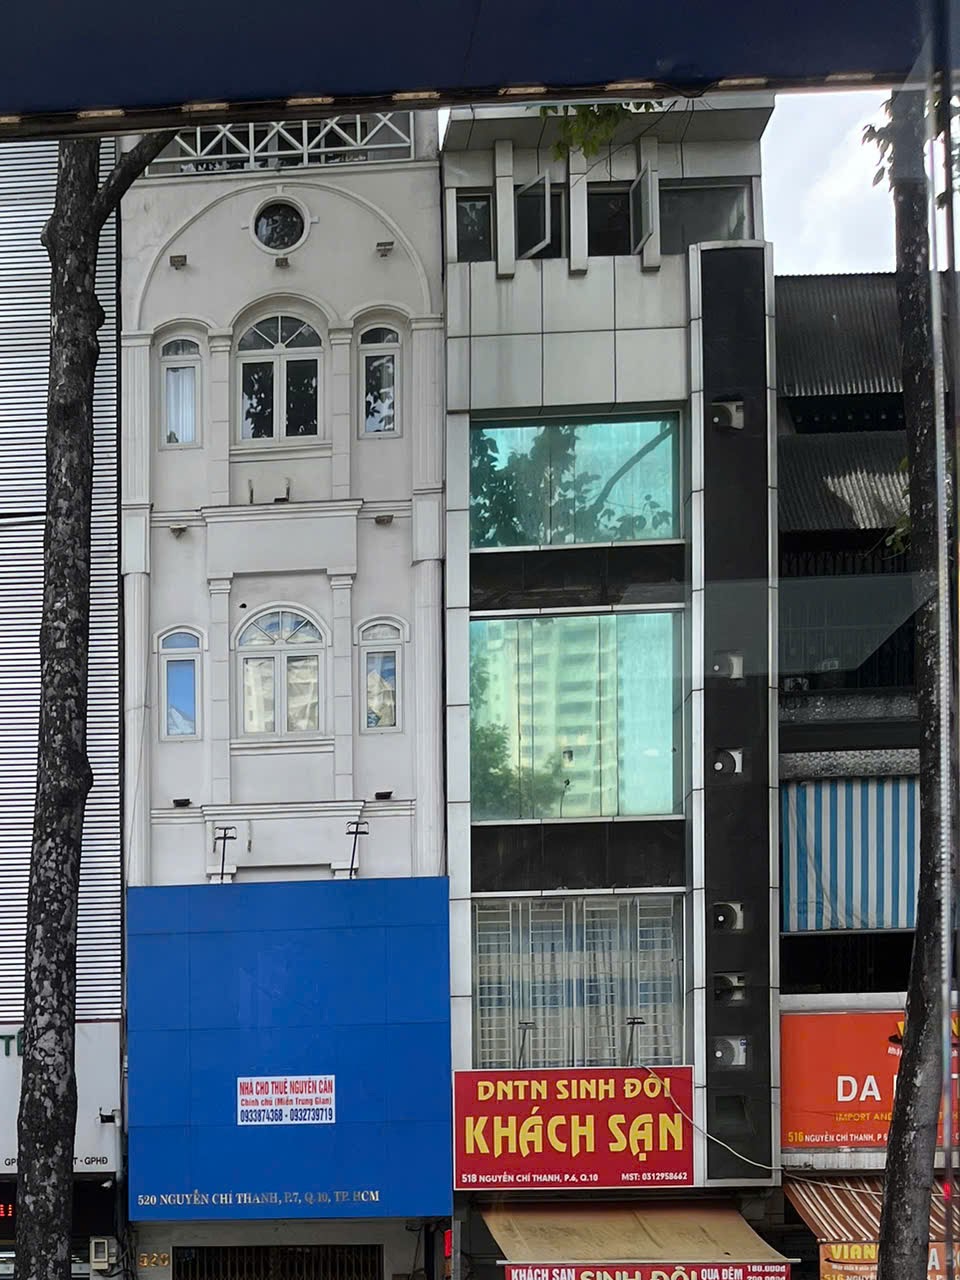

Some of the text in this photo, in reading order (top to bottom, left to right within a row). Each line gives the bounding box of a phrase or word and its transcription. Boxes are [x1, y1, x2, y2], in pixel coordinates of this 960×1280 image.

[240, 1077, 333, 1096] NHÀ CHO THUÊ NGUYÊN CĂN
[477, 1073, 672, 1101] DNTN SINH ĐÔI
[837, 1075, 882, 1102] DA
[464, 1106, 684, 1162] KHÁCH SẠN
[787, 1131, 804, 1143] 516
[461, 1173, 477, 1183] 518
[478, 1172, 515, 1184] NGUYỄN
[515, 1173, 531, 1183] CHÍ
[621, 1172, 640, 1182] MST:
[137, 1194, 157, 1206] 520
[159, 1188, 210, 1206] NGUYỄN
[211, 1189, 233, 1205] CHÍ
[700, 1268, 720, 1280] QUA
[721, 1266, 743, 1280] ĐÊM
